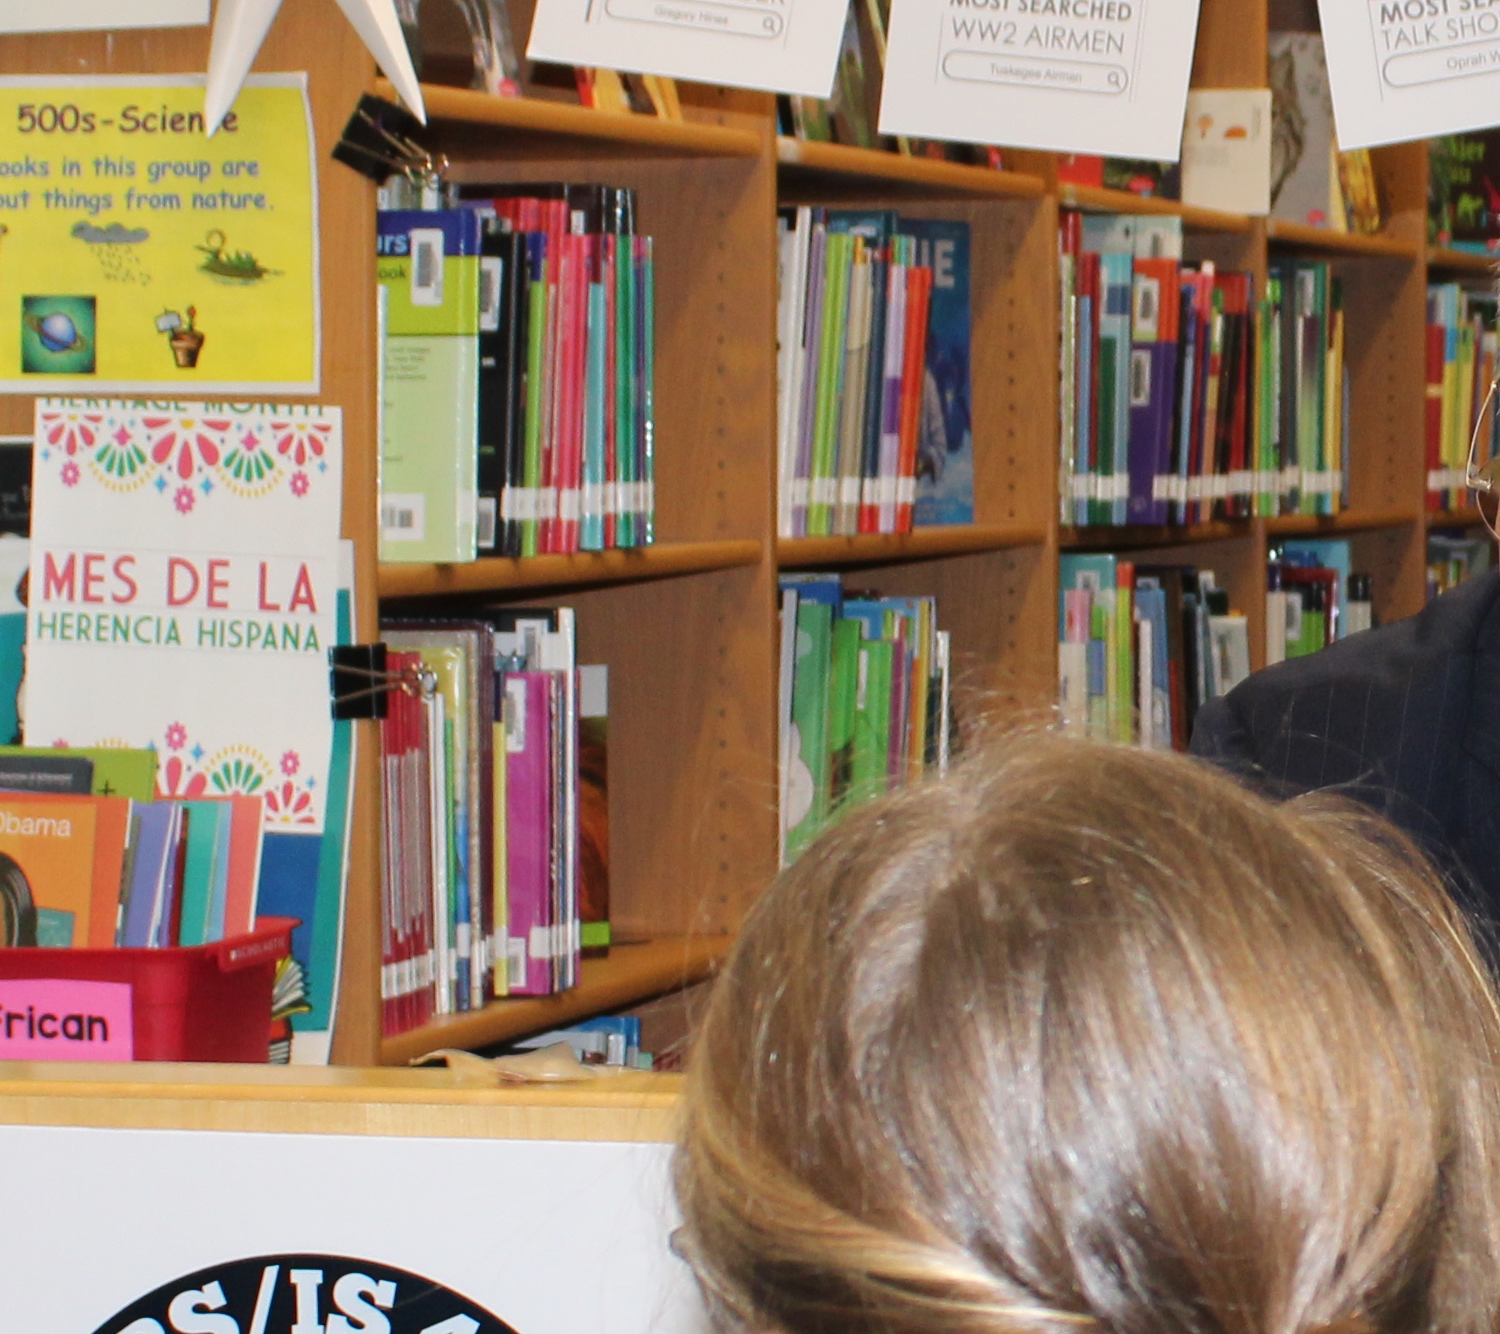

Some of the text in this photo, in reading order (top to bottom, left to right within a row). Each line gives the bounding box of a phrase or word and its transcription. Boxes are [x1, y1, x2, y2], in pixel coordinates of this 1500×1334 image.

[953, 17, 1125, 54] WW2 AIRMEN
[1381, 21, 1439, 51] TALK
[1446, 53, 1487, 71] Oprah
[17, 104, 238, 134] 500s-Sciene
[62, 156, 80, 176] in
[93, 156, 137, 177] this
[147, 160, 212, 183] group
[222, 159, 260, 177] are
[42, 188, 112, 216] things
[125, 188, 180, 210] from
[192, 188, 275, 211] nature.
[44, 551, 317, 614] MES DE LA
[37, 612, 320, 653] HERENCIA HISPANA
